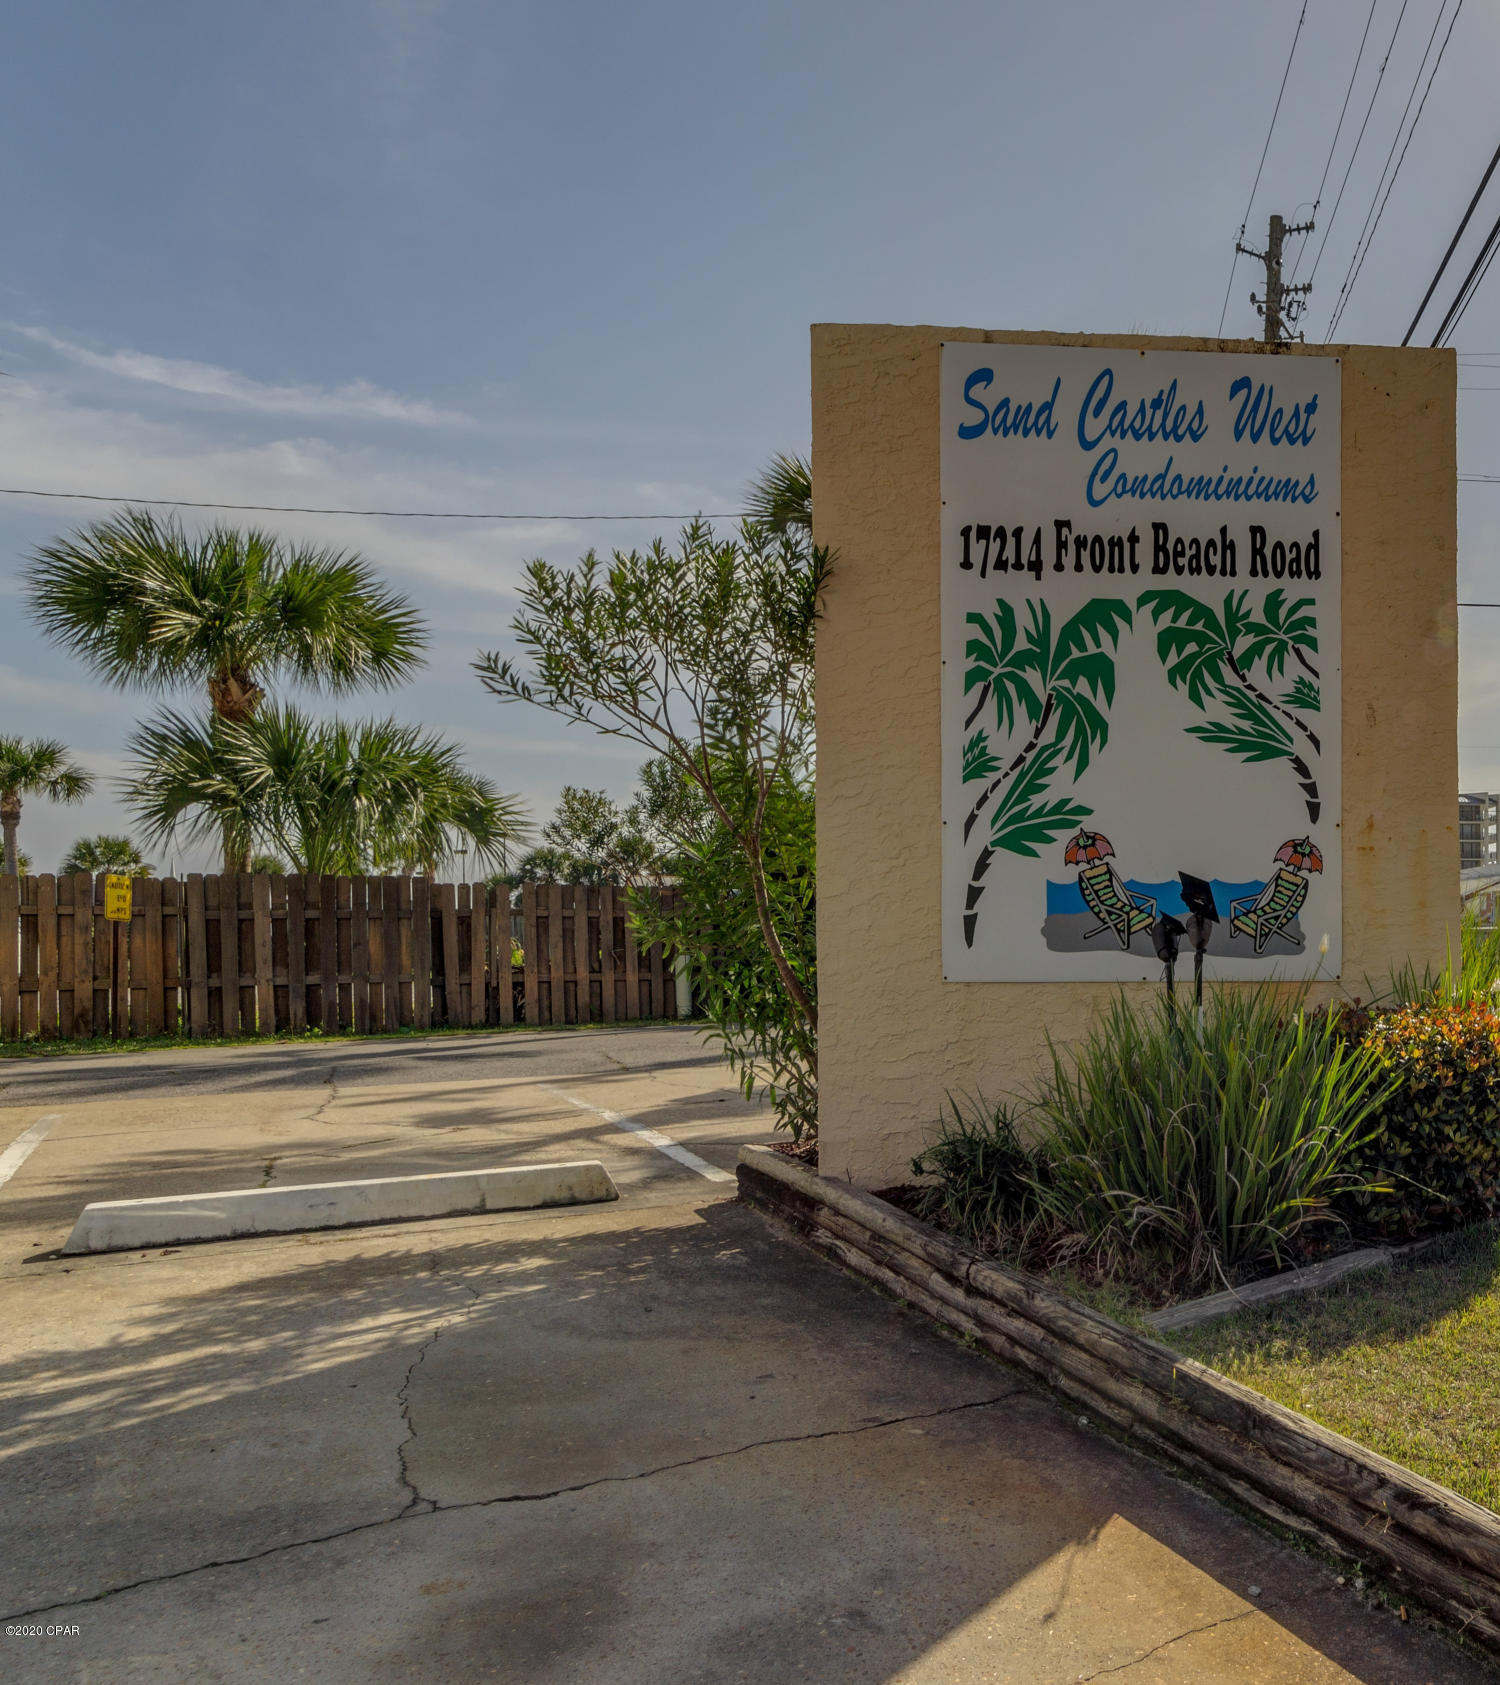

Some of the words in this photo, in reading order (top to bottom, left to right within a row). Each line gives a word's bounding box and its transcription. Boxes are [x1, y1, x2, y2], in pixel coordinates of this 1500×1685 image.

[957, 367, 1061, 440] Sand
[1077, 367, 1208, 451] Castles
[1229, 375, 1318, 446] West
[1086, 447, 1319, 508] Condominiums
[959, 523, 1043, 582] 17214
[1052, 518, 1141, 575] Front
[1151, 521, 1238, 579] Beach
[1248, 524, 1322, 581] Road
